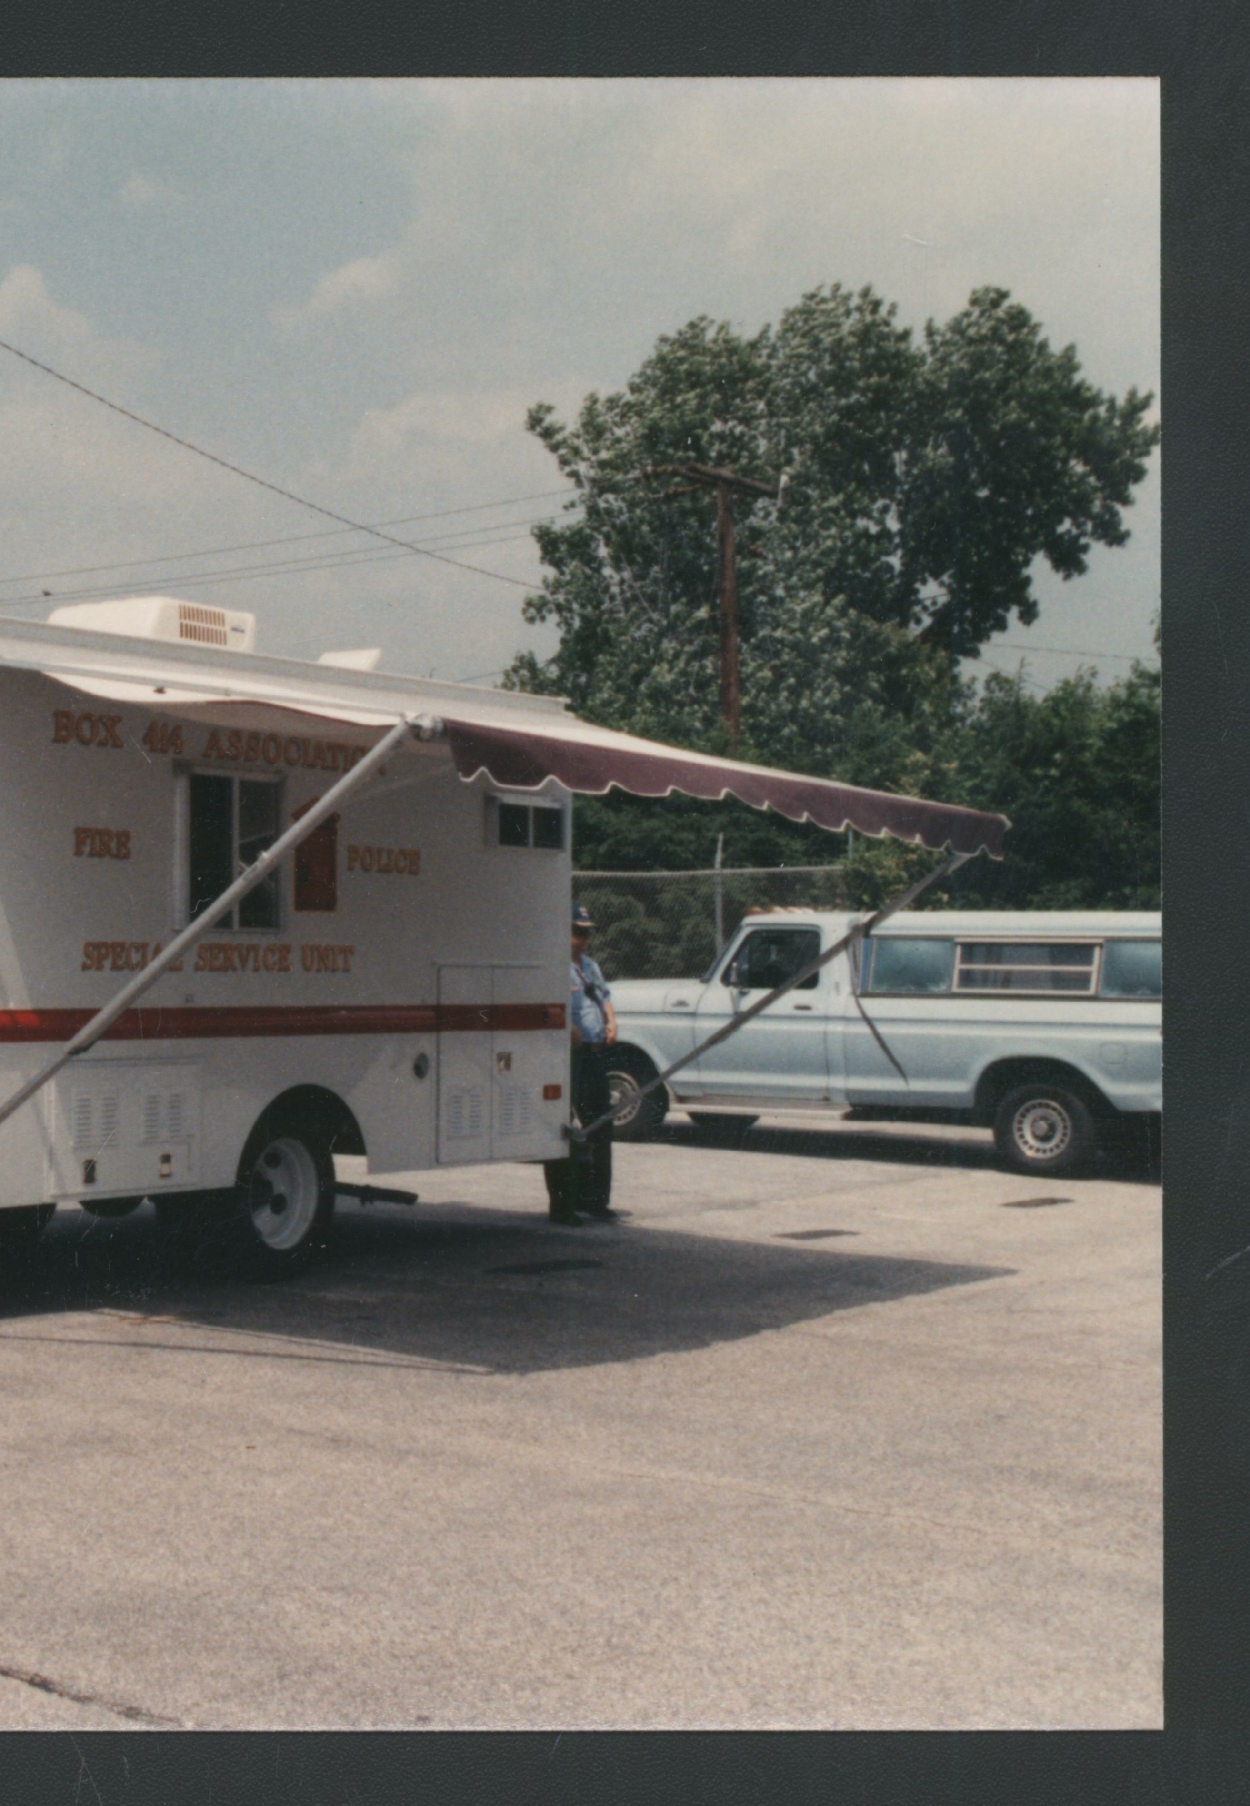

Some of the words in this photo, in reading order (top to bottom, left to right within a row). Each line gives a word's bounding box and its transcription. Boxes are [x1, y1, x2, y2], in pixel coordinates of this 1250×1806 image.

[52, 710, 123, 748] BOX
[142, 720, 184, 755] 414
[203, 729, 387, 776] ASSOCIATI
[73, 827, 131, 860] FIRE
[348, 846, 421, 875] POLICE
[194, 942, 293, 972] SERVICE
[301, 944, 355, 972] UNIT
